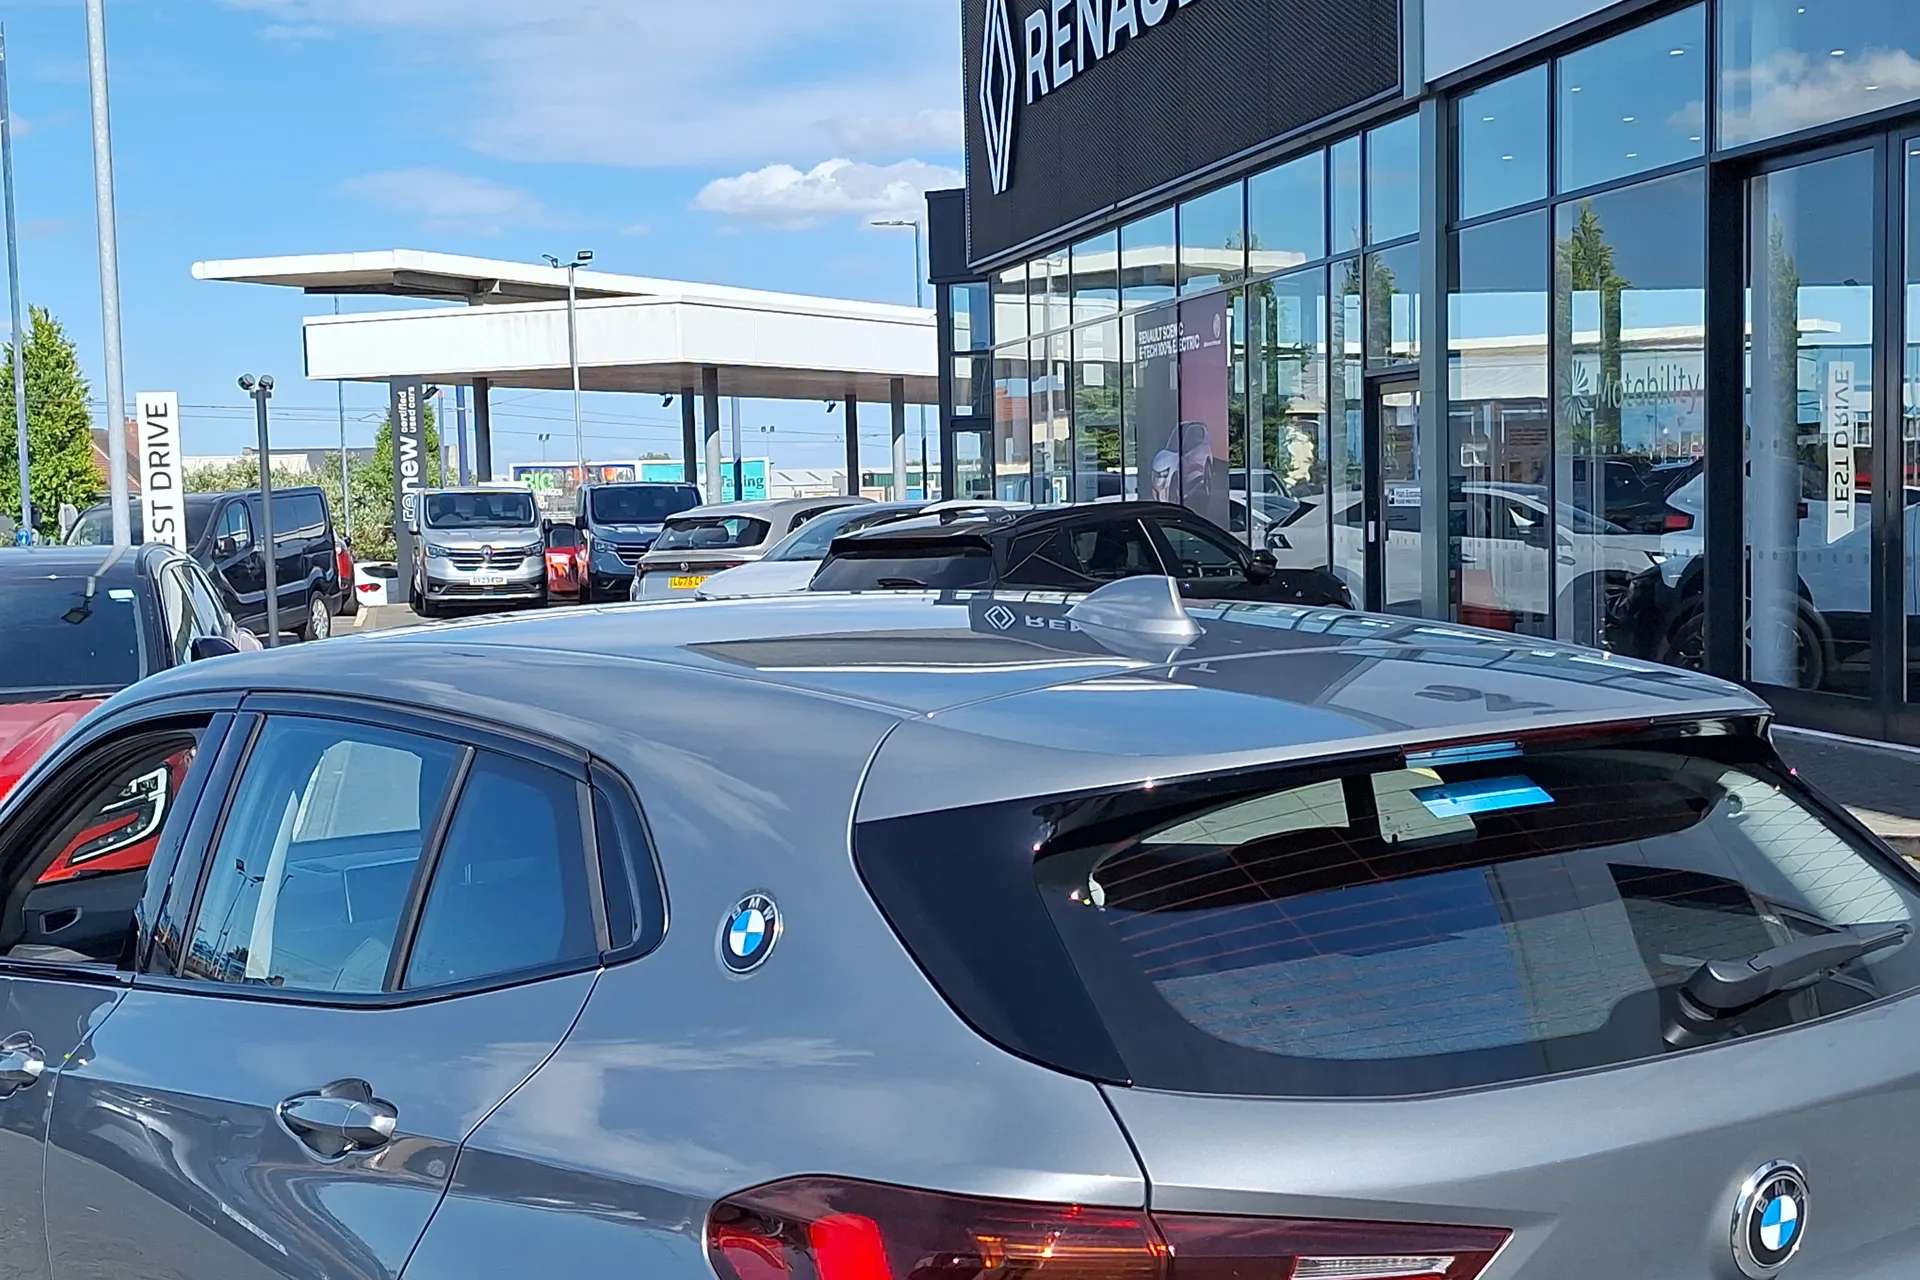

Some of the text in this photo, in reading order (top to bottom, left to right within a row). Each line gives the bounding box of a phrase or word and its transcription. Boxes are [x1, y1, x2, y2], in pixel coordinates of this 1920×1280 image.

[1138, 322, 1184, 344] RENAULT SCENC
[1173, 334, 1200, 353] EECTRIC
[1596, 364, 1700, 415] Motability
[407, 386, 417, 433] used cars
[146, 402, 172, 490] DRIVE
[720, 474, 765, 490] Taing
[731, 897, 775, 921] BMW
[1756, 1179, 1804, 1213] BMW
